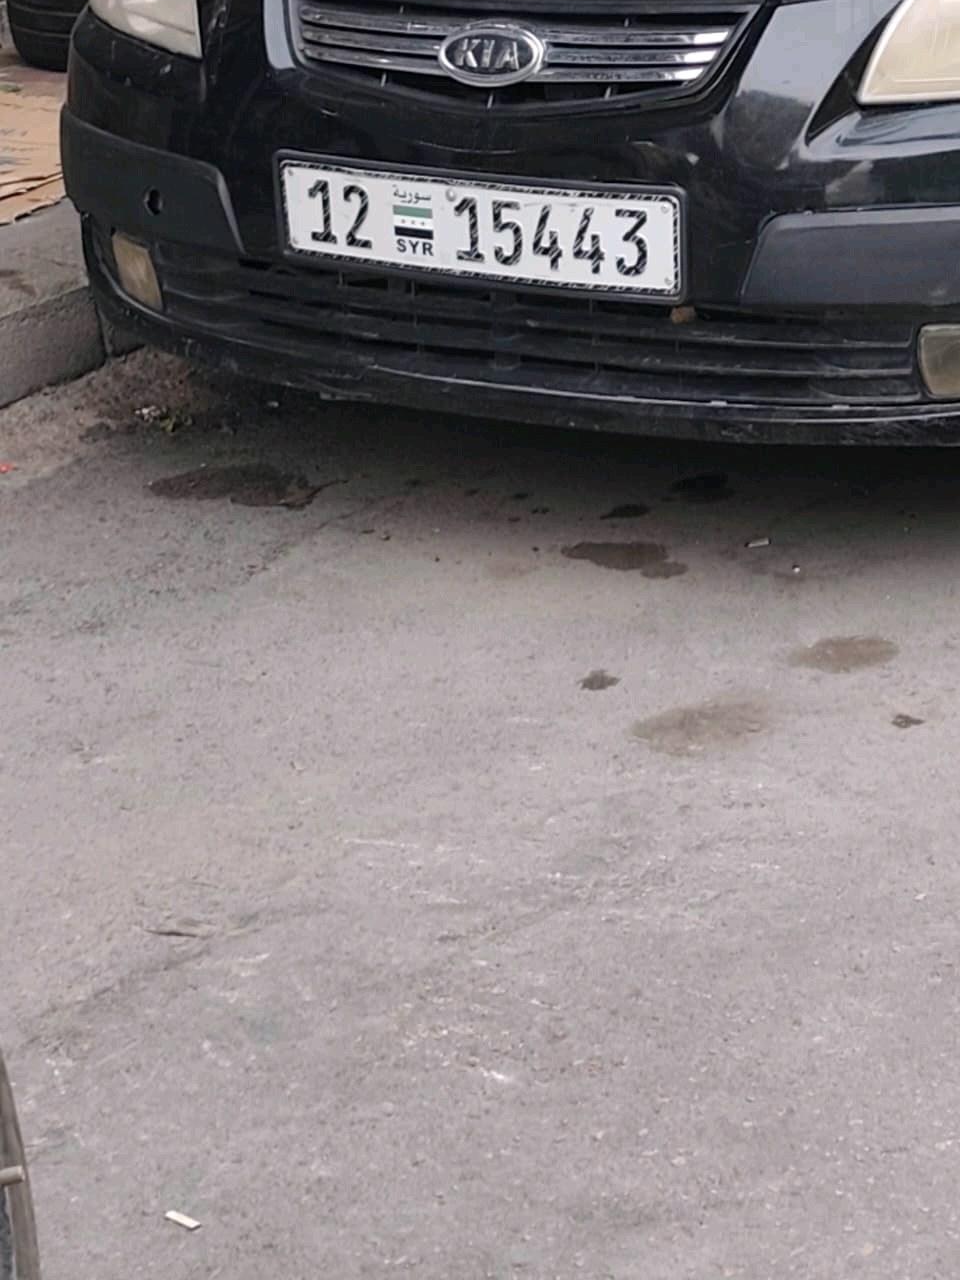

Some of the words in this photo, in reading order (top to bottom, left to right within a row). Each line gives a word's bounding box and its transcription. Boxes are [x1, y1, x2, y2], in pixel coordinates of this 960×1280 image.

[453, 38, 520, 71] KIA
[392, 184, 432, 204] سورية
[307, 179, 373, 250] 12
[396, 238, 434, 257] SYR
[453, 195, 648, 278] 15443
